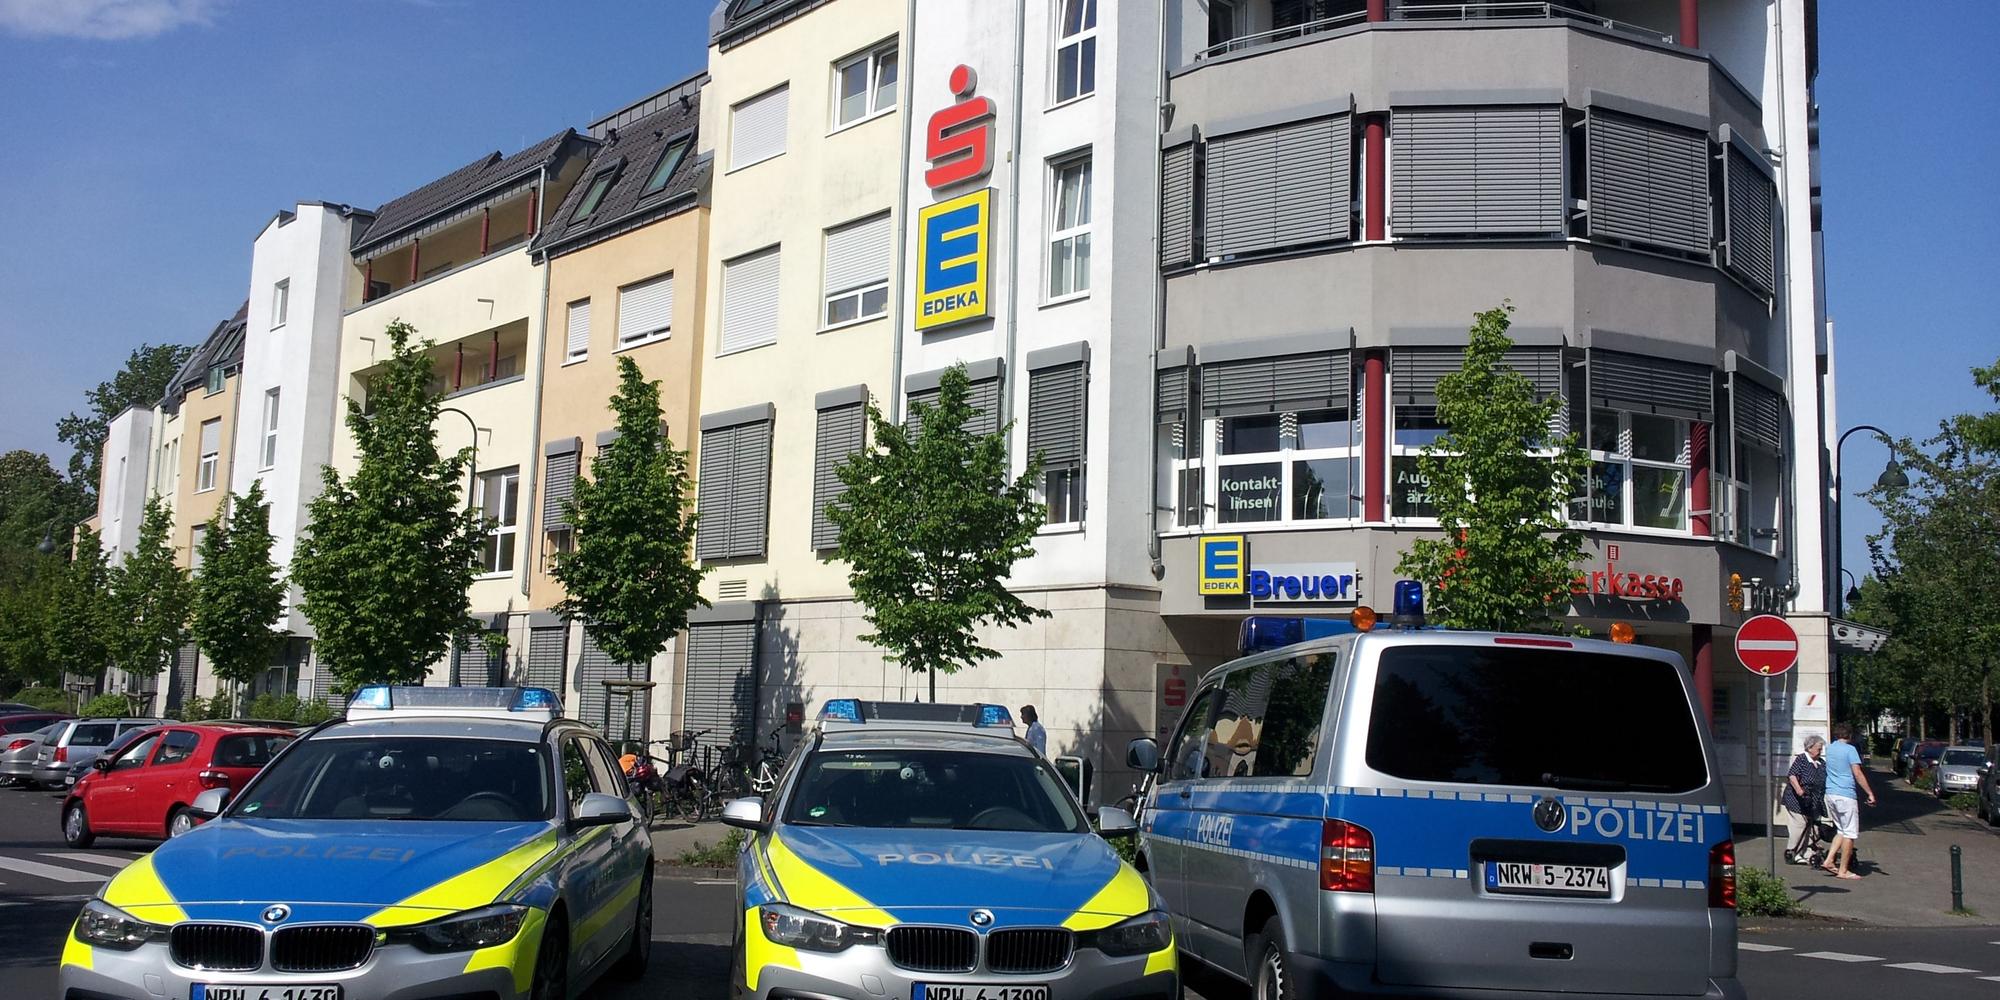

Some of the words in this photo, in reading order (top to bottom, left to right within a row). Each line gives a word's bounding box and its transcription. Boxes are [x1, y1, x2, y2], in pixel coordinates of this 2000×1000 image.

[923, 289, 979, 316] EDEKA
[1221, 476, 1282, 492] Kontakt-
[1230, 496, 1273, 510] linsen
[1204, 582, 1240, 590] EDEKA
[1251, 570, 1354, 600] Breuer
[1196, 814, 1235, 847] POLIZEI
[1571, 805, 1704, 844] POLIZEI
[223, 845, 416, 863] POLIZEI
[877, 852, 1055, 871] POLIZEI
[1498, 863, 1532, 885] NRW
[1544, 865, 1606, 889] 5-2374
